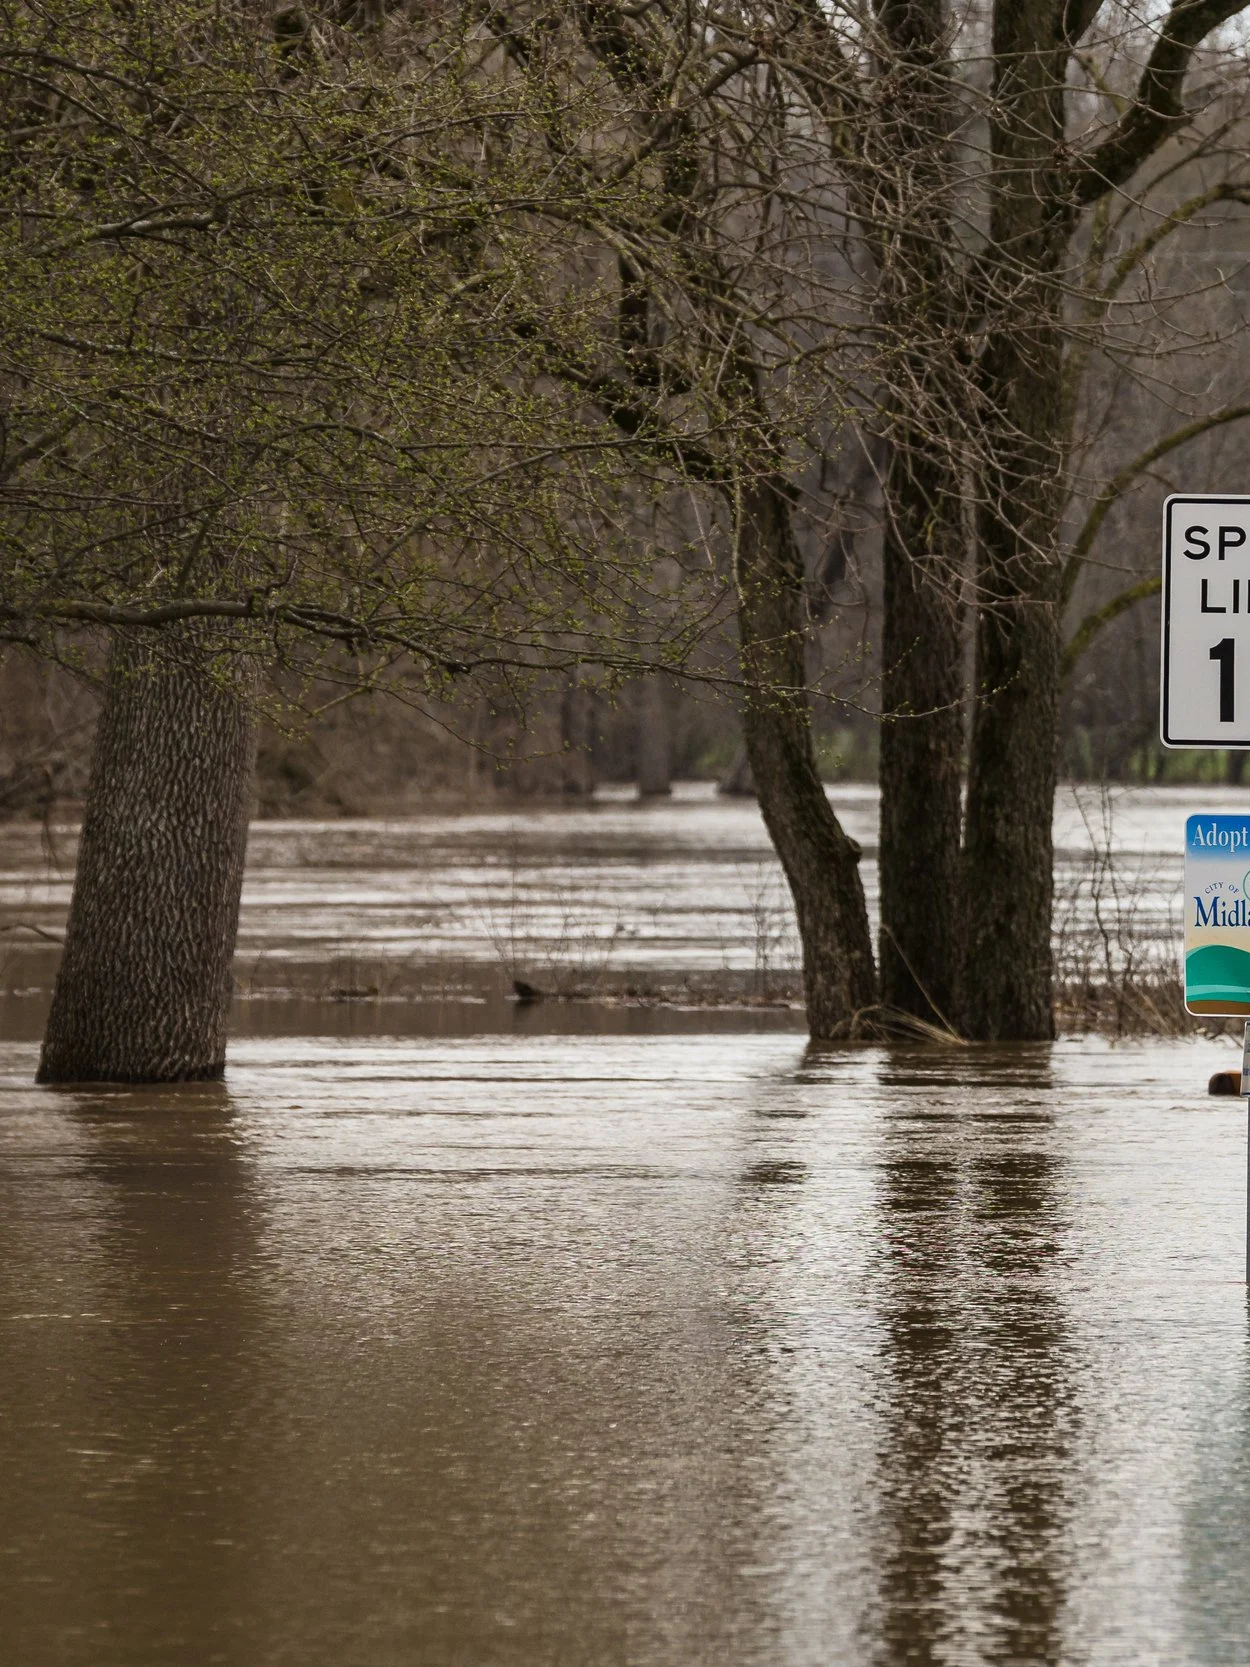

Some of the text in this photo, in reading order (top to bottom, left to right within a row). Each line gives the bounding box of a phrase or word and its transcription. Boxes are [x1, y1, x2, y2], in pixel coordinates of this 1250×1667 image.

[1192, 822, 1248, 853] Adopt
[1204, 881, 1240, 894] CITY OF
